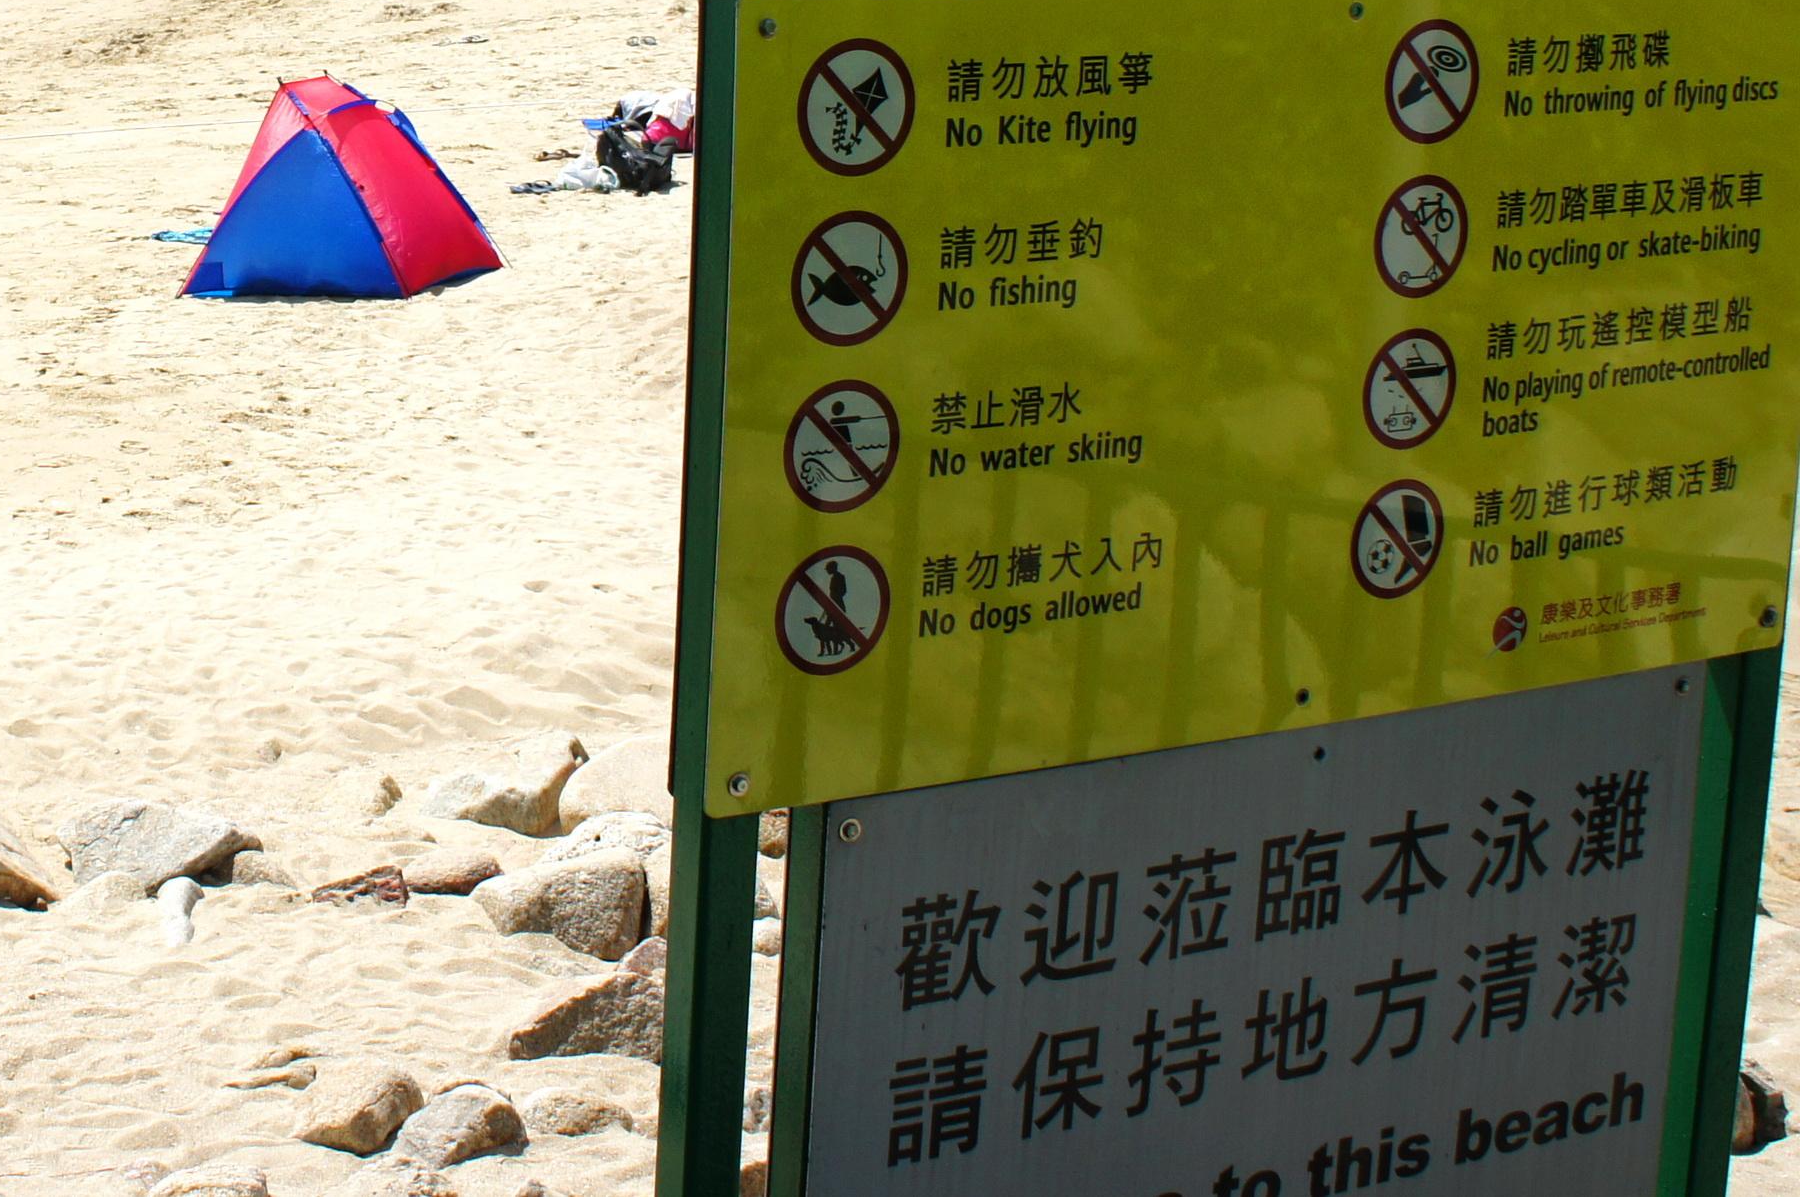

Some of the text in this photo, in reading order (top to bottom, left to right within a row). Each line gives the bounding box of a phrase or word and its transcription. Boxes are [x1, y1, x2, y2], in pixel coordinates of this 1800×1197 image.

[947, 52, 1153, 103] 請勿放風箏
[1507, 30, 1670, 77] 請勿擲飛碟
[1504, 76, 1779, 118] No throwing of flying discs
[946, 111, 1137, 148] No Kite flying
[1496, 169, 1764, 230] 請勿踏單車及滑板車
[940, 217, 1103, 270] 請勿垂釣
[1492, 223, 1761, 275] No cycling or skate-biking
[938, 275, 1077, 311] No fishing
[1486, 296, 1753, 361] 請勿玩遙控模型船
[1482, 343, 1771, 405] No playing of remote-controlled
[930, 381, 1082, 435] 禁止滑水
[1482, 408, 1539, 437] boats
[929, 431, 1143, 477] No water skiing
[1473, 455, 1738, 529] 請勿進行球類活動
[1469, 525, 1625, 568] No ball games
[919, 581, 1142, 638] No dogs allowed
[895, 769, 1649, 1011] 歡迎蒞臨本泳灘
[887, 913, 1637, 1167] 請保持地方清潔
[1212, 1072, 1645, 1197] to this beach
